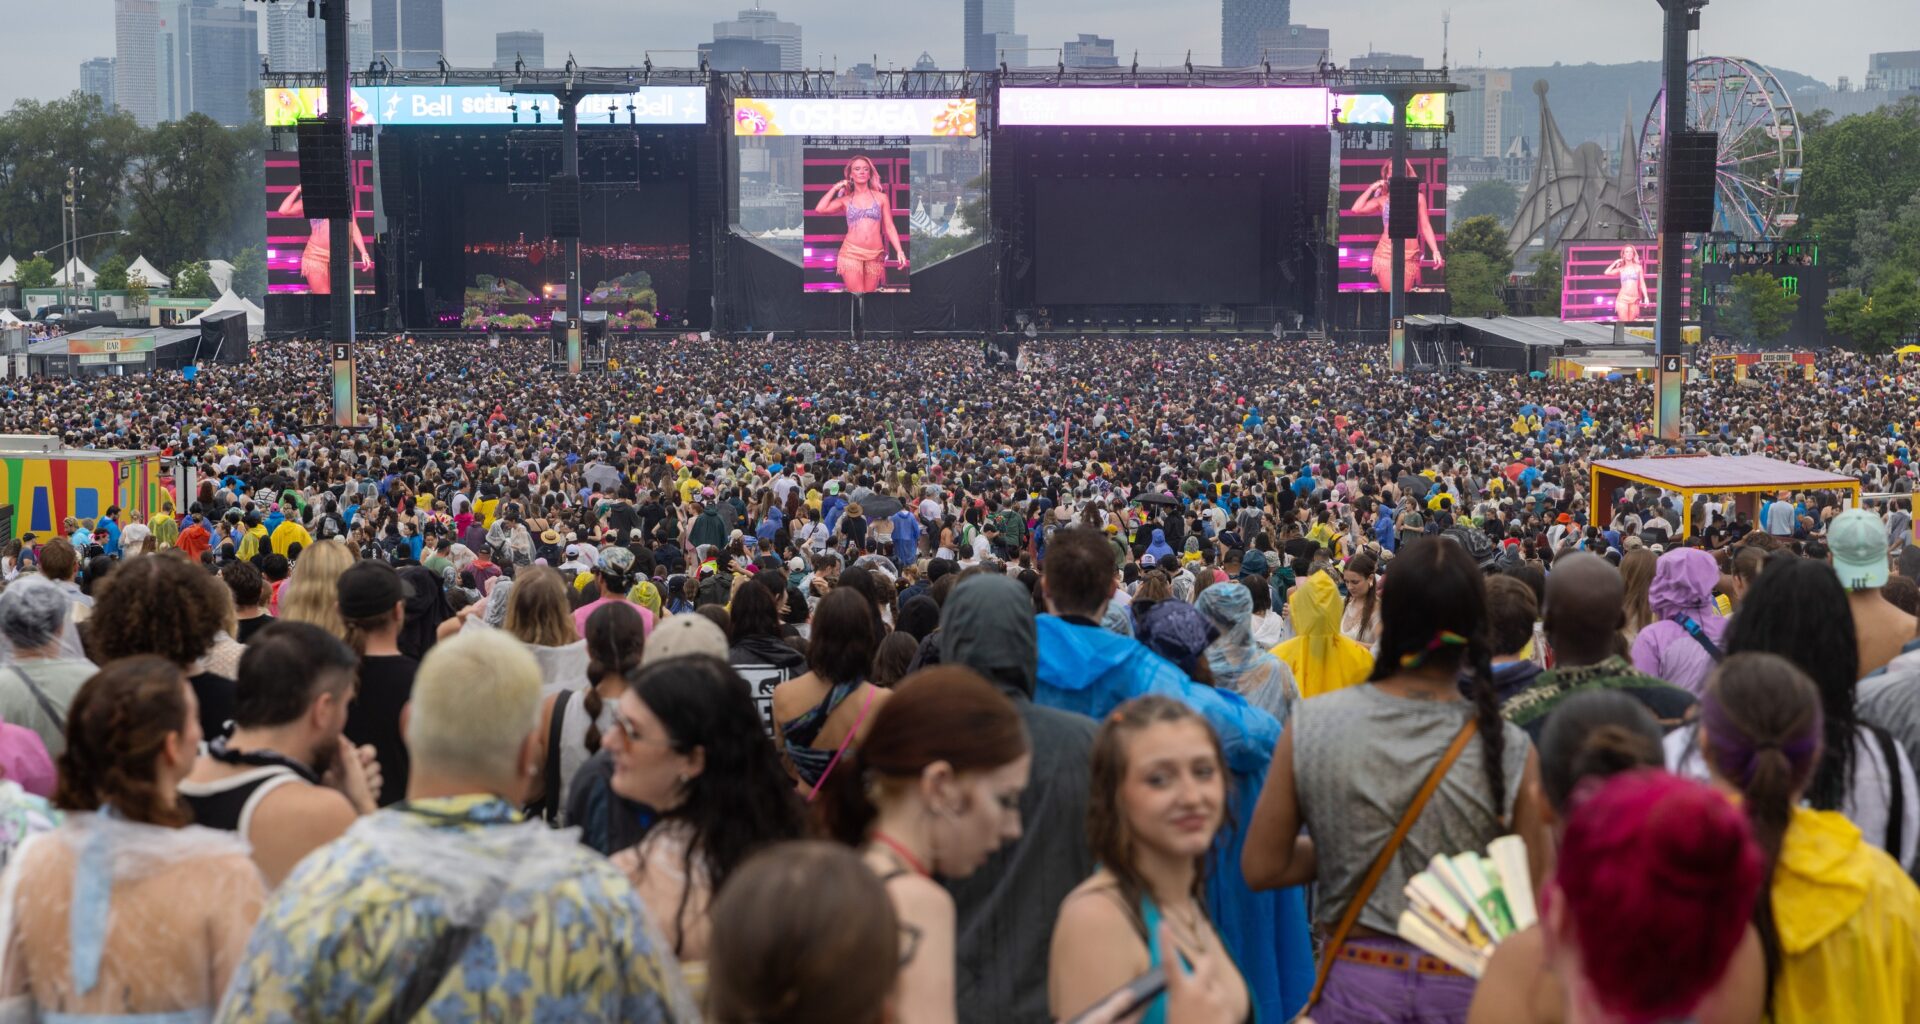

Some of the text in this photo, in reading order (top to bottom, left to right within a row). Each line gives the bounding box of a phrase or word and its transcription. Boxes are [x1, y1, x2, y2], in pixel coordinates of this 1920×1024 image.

[412, 94, 452, 117] Bell
[633, 94, 672, 117] Bell
[788, 103, 921, 131] OSHEAGA
[570, 271, 575, 280] 2
[570, 320, 576, 329] 2
[1396, 320, 1401, 329] 3
[106, 341, 119, 350] BAR
[337, 346, 345, 359] 5
[1668, 358, 1676, 370] 6
